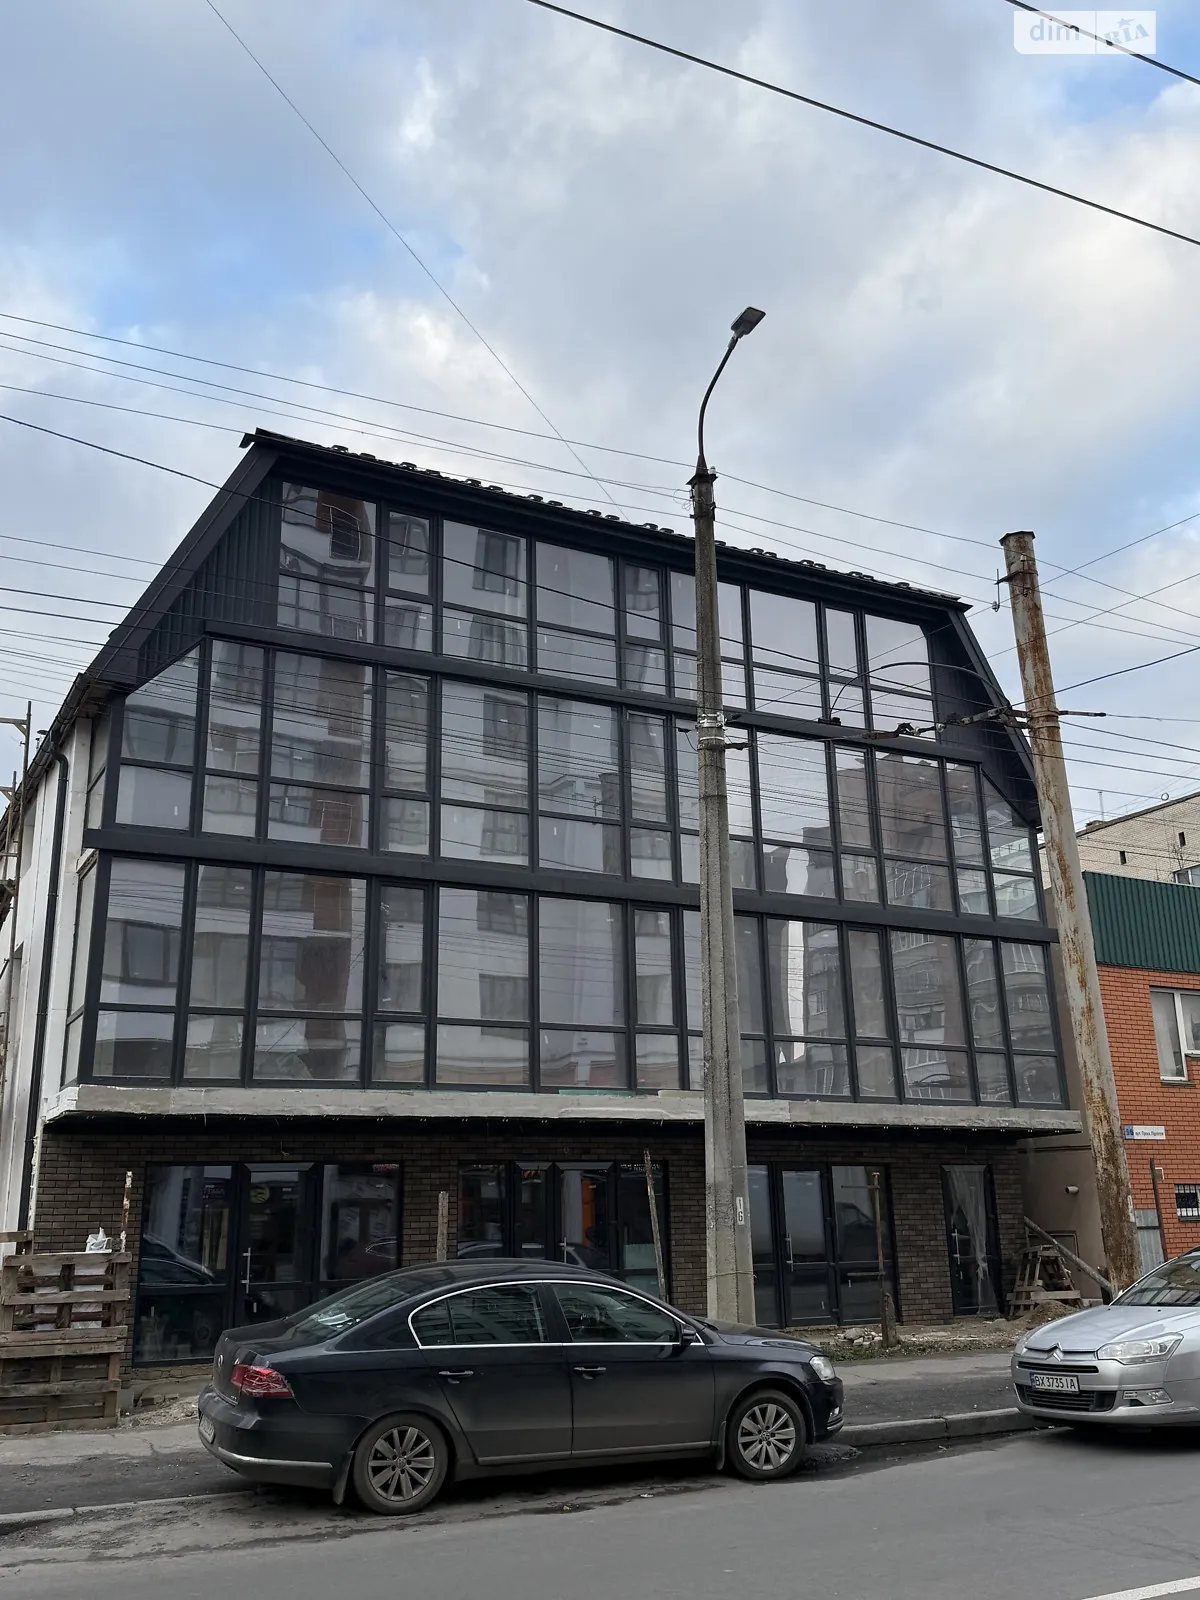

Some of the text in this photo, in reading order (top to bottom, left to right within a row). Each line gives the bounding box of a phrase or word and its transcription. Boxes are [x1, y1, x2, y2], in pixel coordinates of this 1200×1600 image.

[1035, 1375, 1076, 1390] BX 3735 IA
